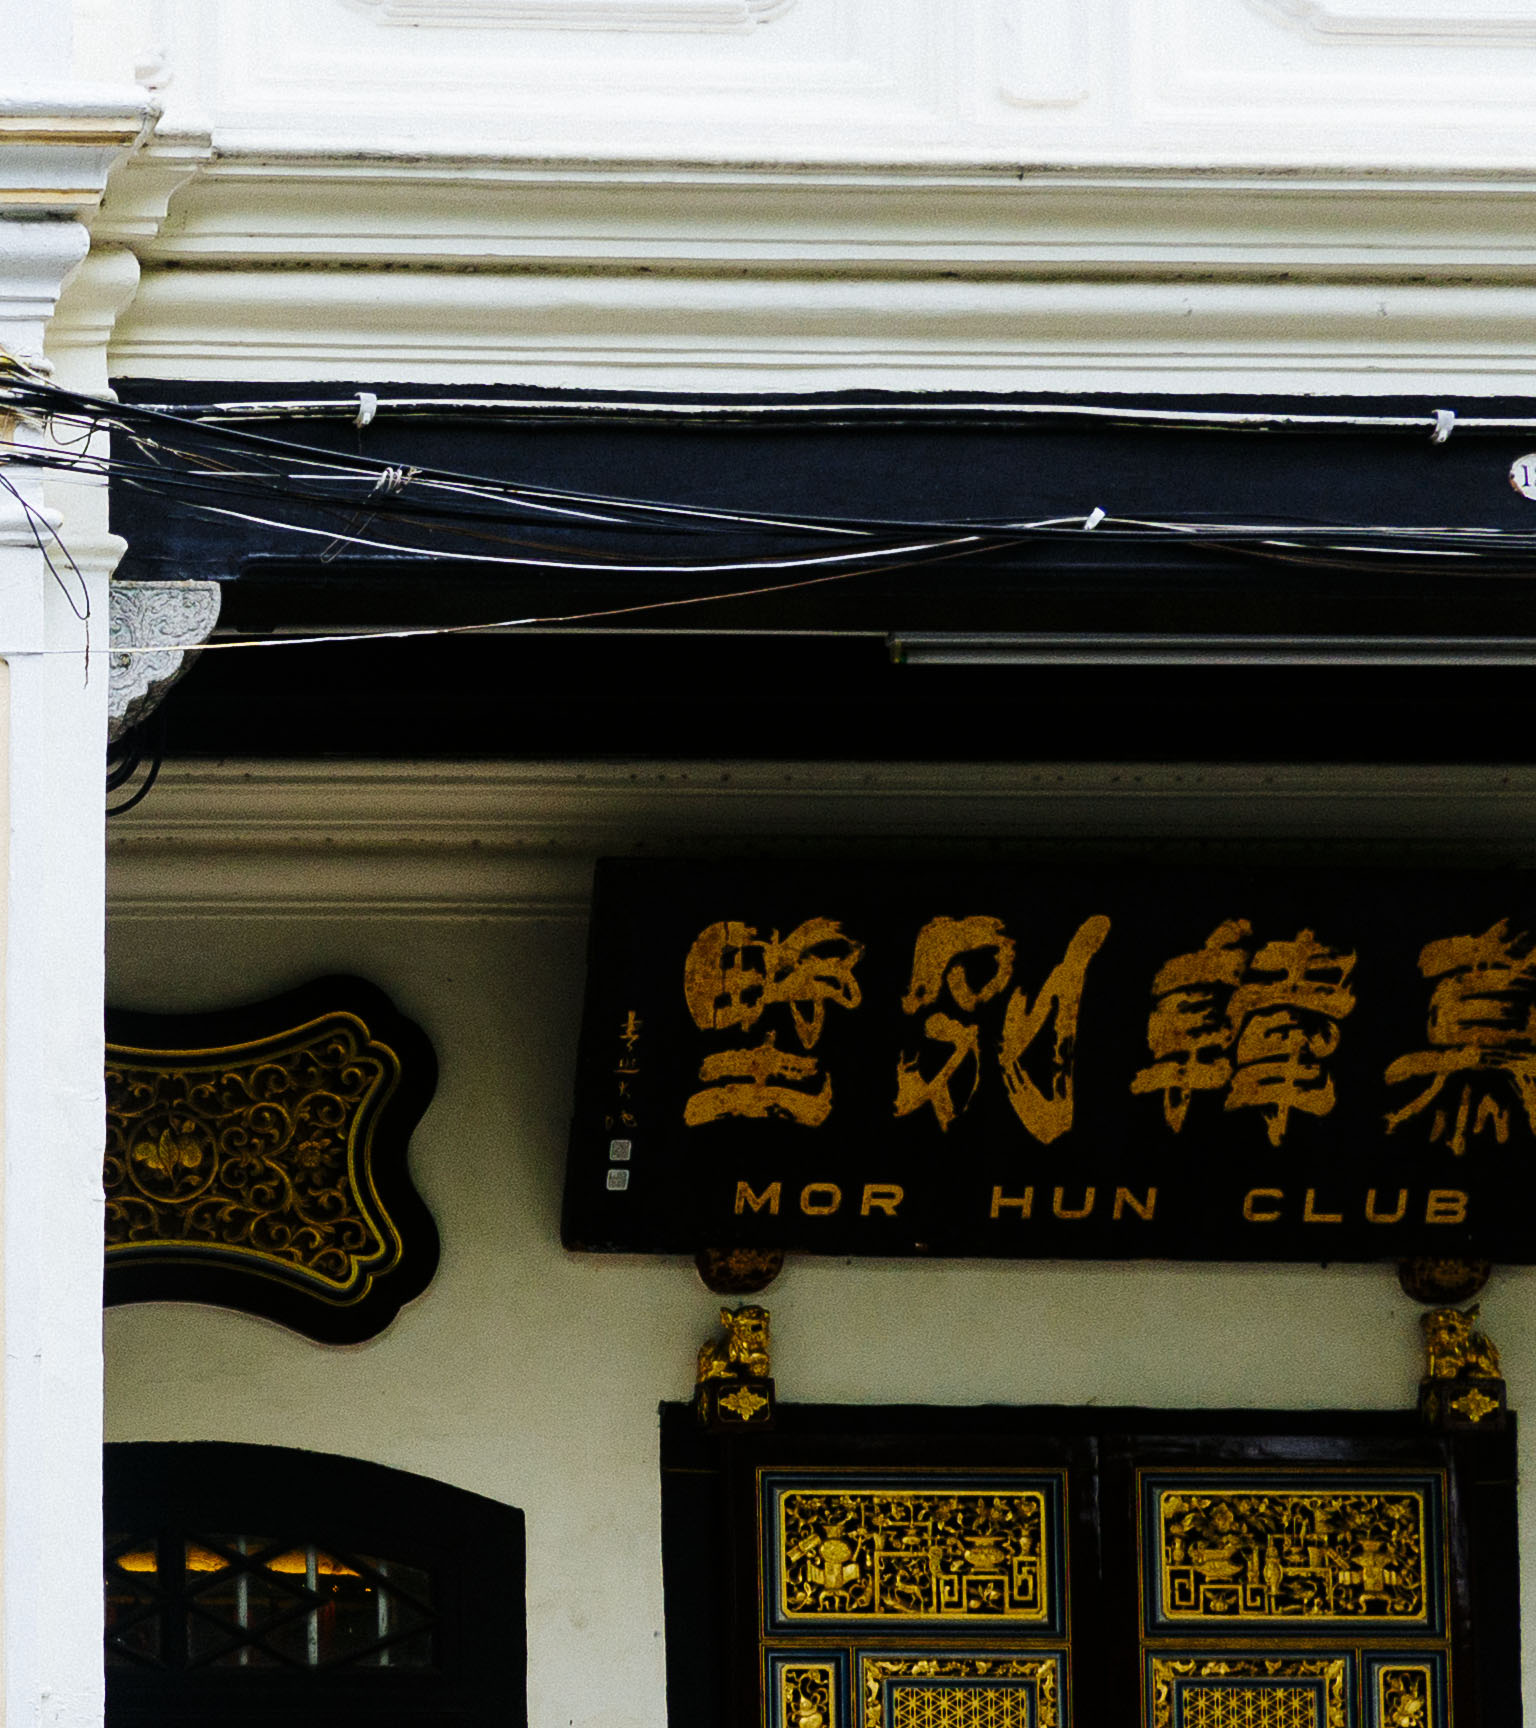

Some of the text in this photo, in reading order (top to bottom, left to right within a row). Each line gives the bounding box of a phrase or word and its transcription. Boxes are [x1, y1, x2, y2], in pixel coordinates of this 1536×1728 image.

[733, 1182, 1472, 1225] MOR HUN CLUB
